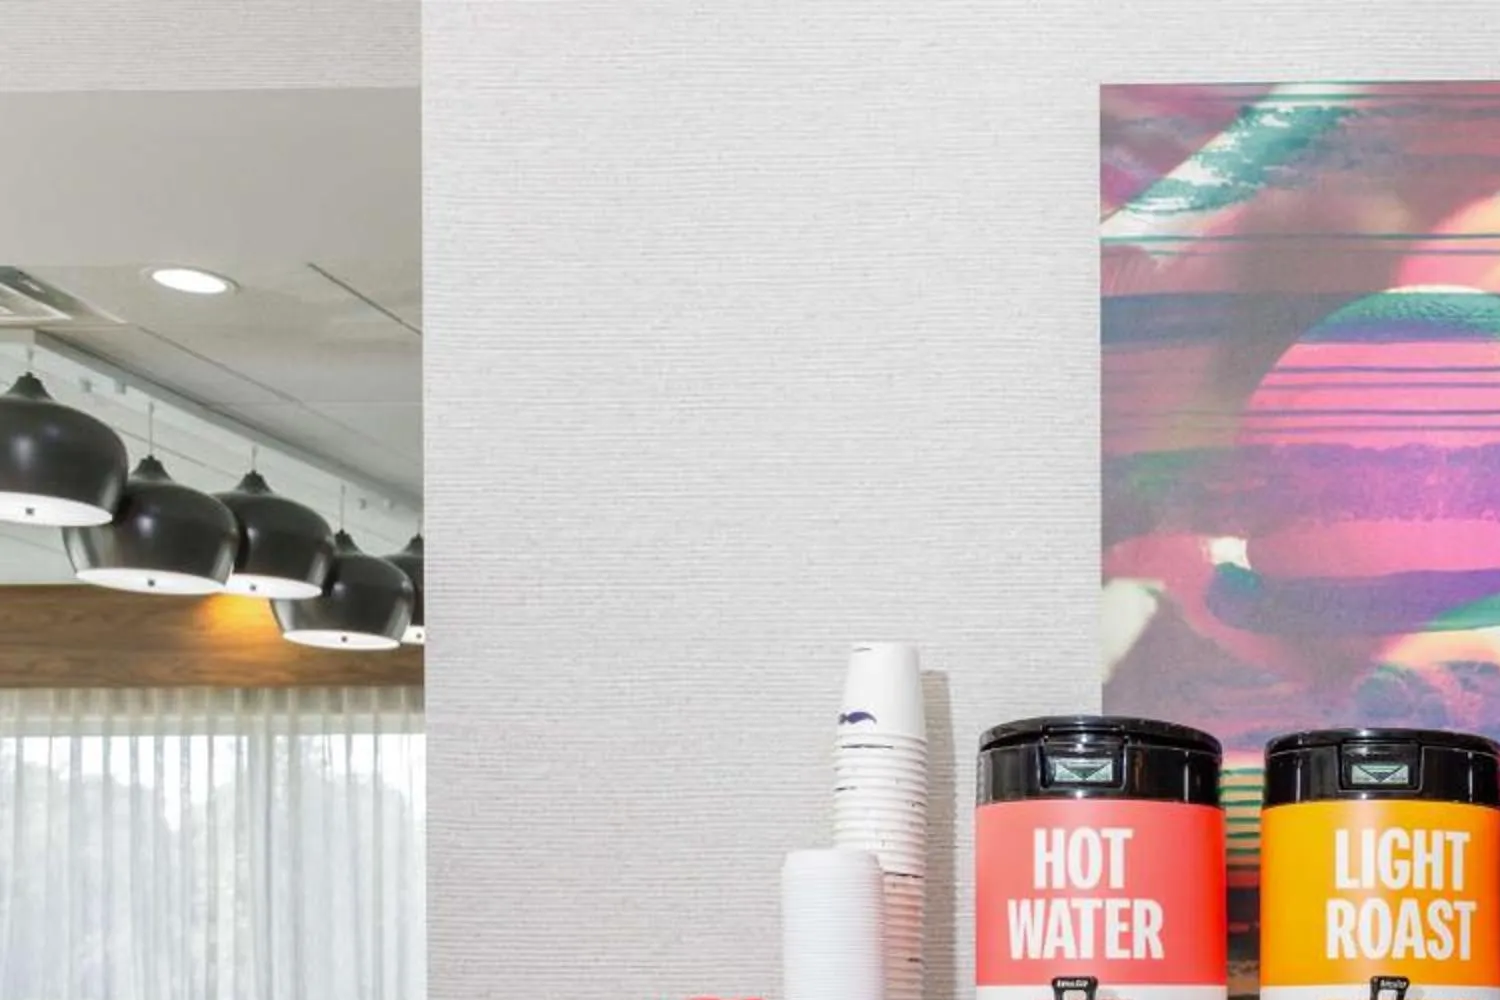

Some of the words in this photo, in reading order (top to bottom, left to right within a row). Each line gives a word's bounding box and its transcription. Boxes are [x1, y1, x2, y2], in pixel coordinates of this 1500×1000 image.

[1033, 828, 1133, 890] HOT
[1334, 829, 1471, 890] LIGHT
[1007, 898, 1165, 960] WATER
[1325, 898, 1477, 960] ROAST
